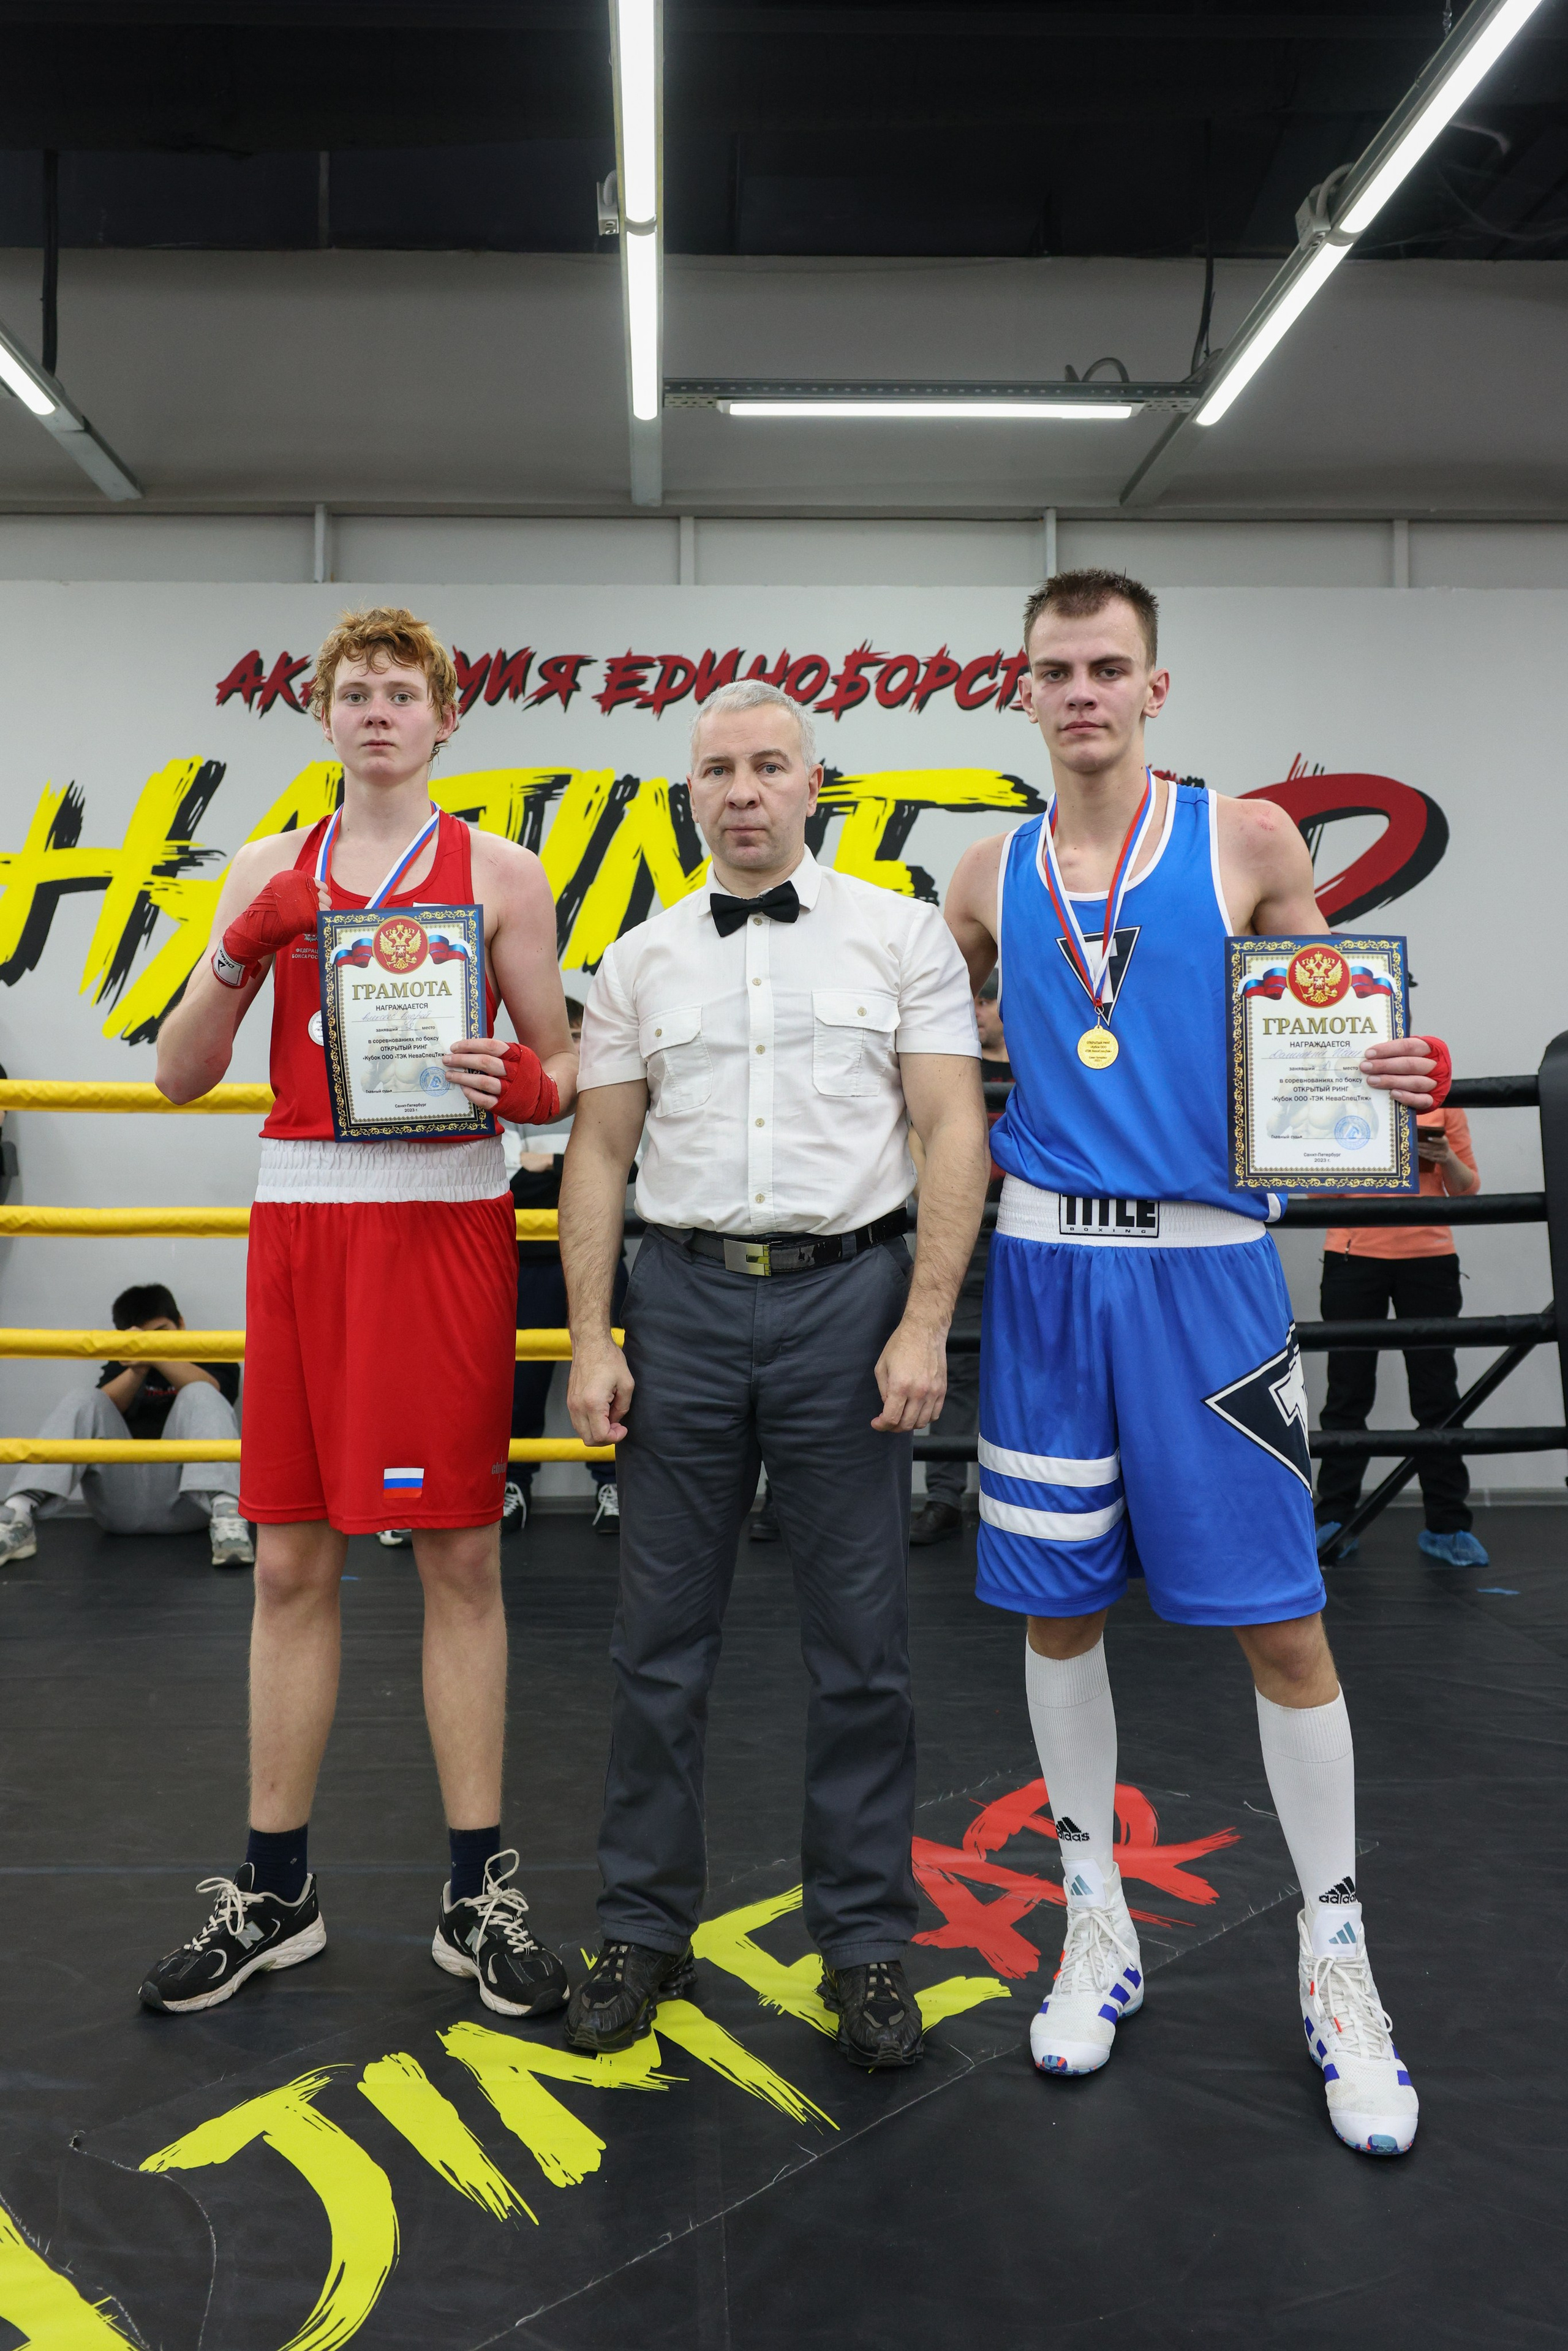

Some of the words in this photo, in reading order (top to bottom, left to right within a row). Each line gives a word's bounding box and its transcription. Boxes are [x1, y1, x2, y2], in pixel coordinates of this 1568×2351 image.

[592, 640, 1031, 722] ЕДИНОБОРСТ
[352, 980, 452, 1000] ГРАМОТА
[1262, 1016, 1378, 1035] ГРАМОТА
[1055, 1829, 1090, 1841] didas
[1319, 1893, 1356, 1904] adida
